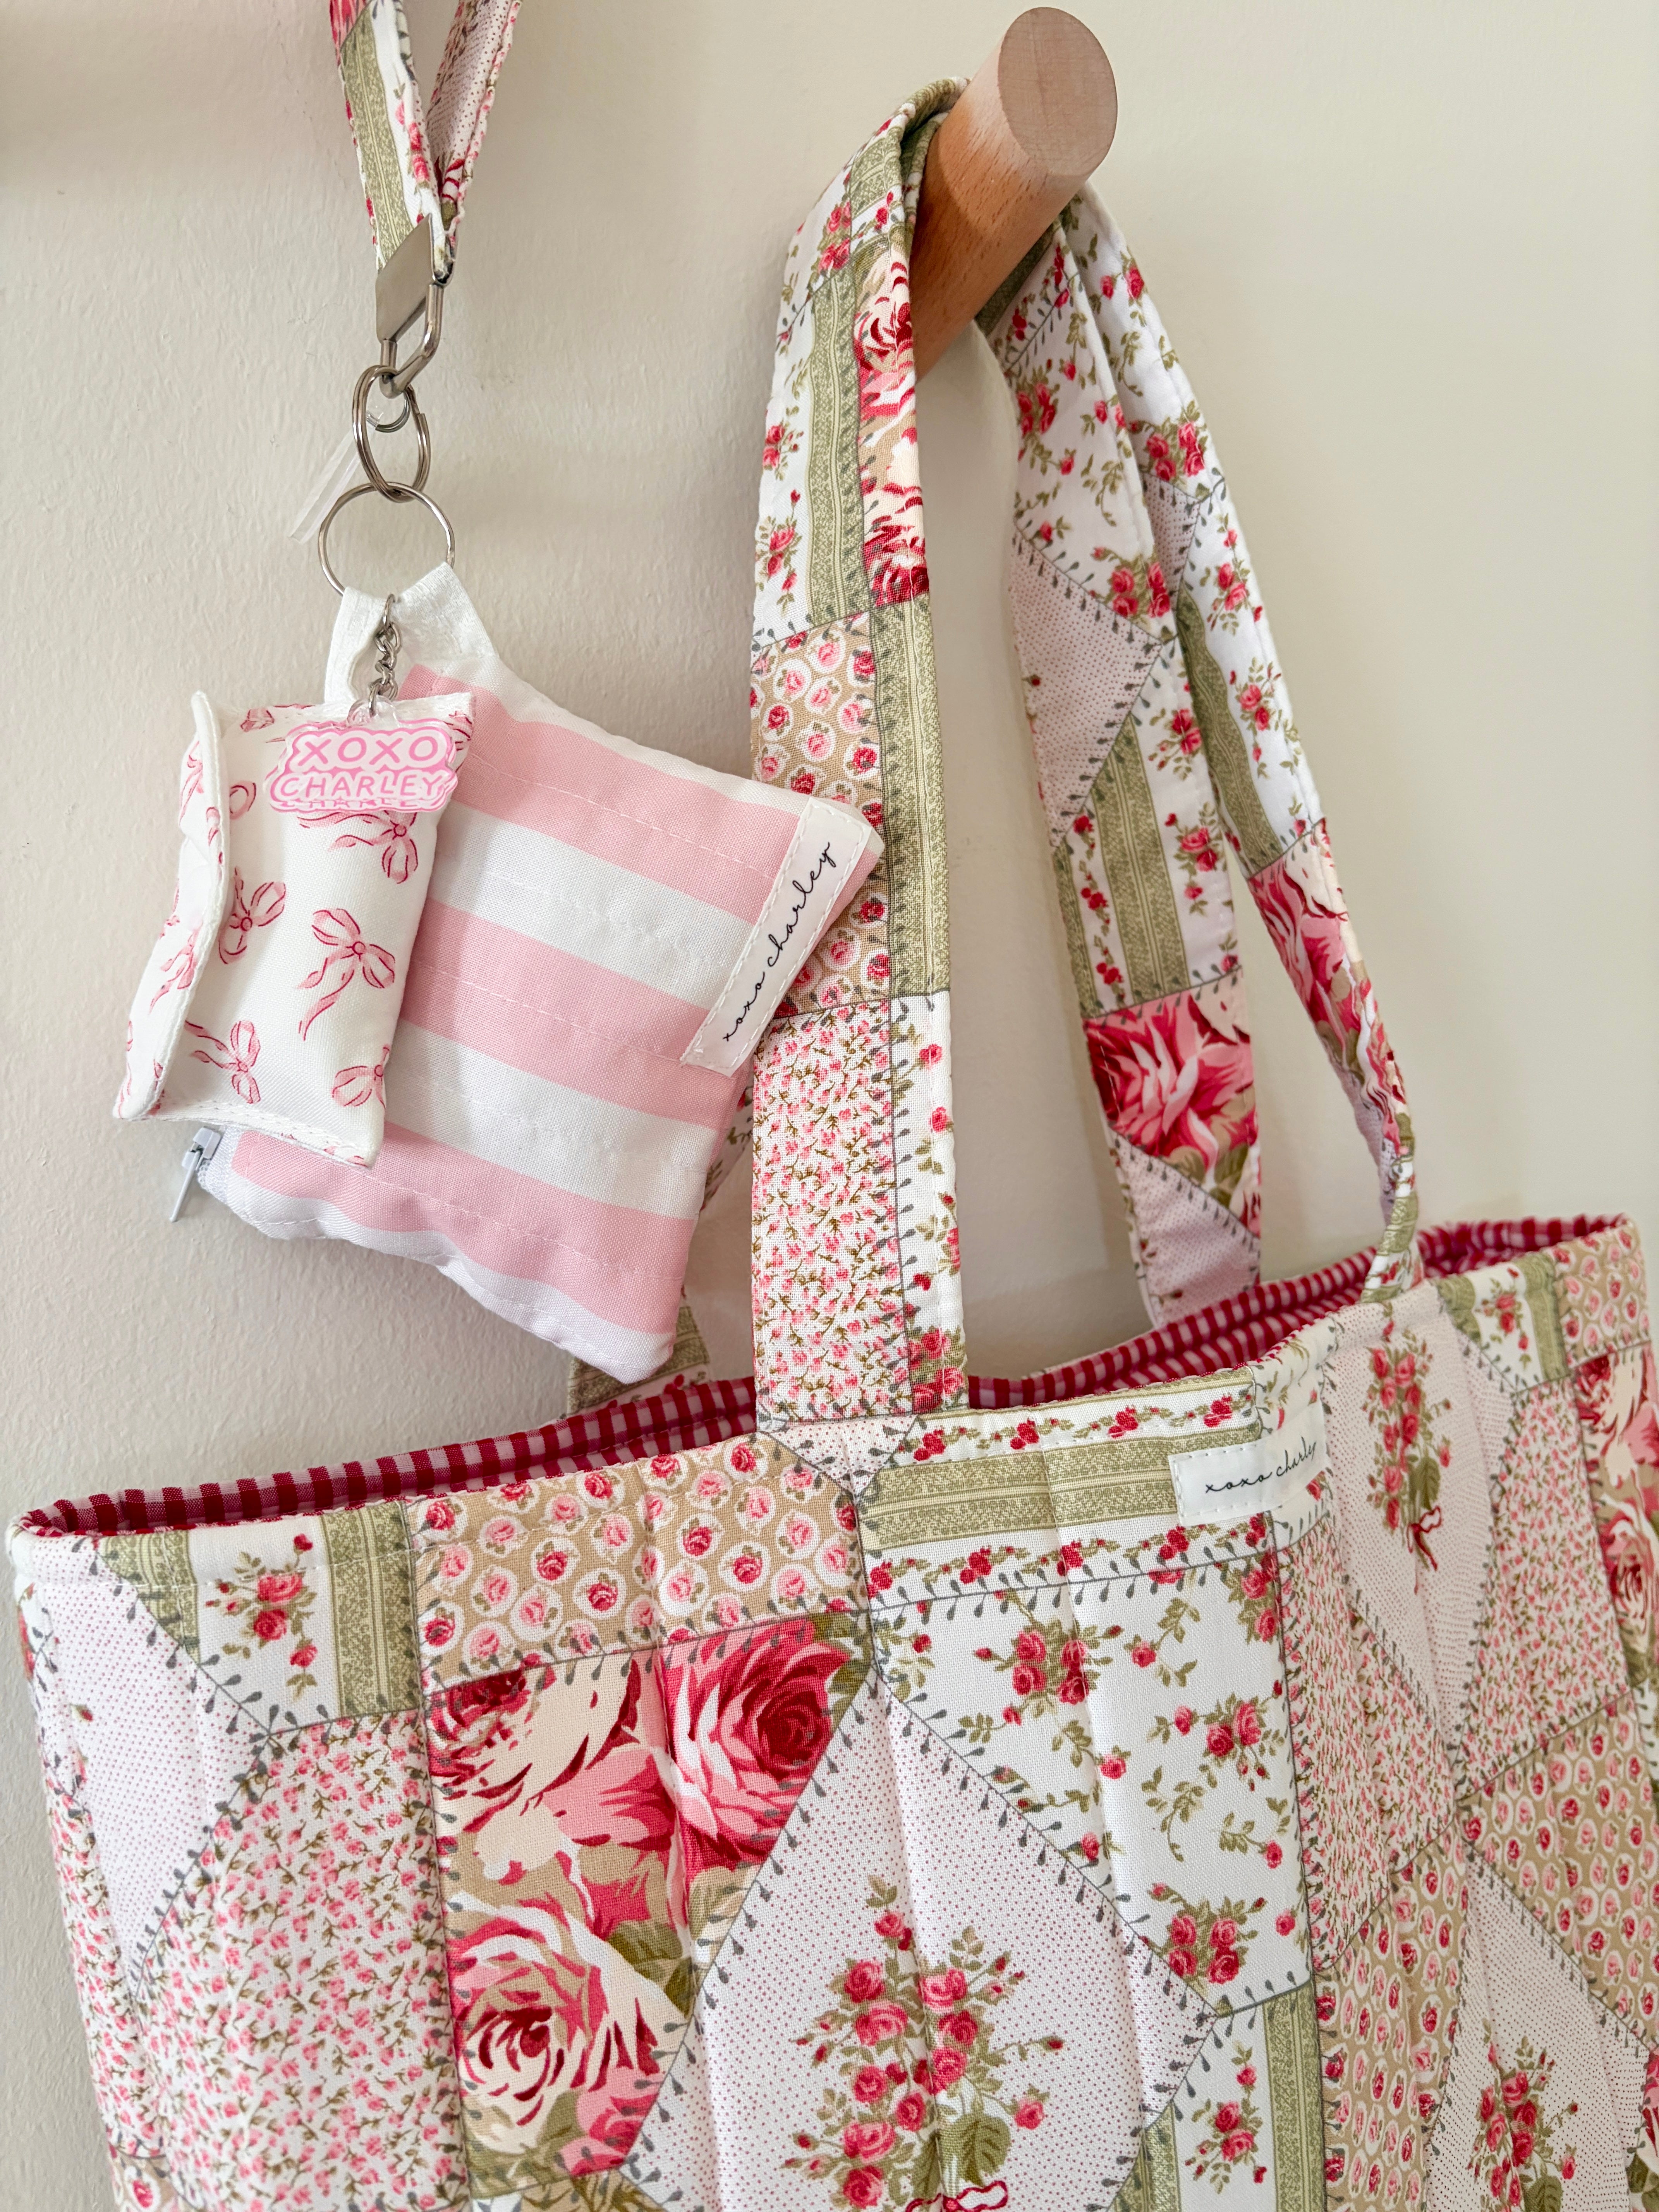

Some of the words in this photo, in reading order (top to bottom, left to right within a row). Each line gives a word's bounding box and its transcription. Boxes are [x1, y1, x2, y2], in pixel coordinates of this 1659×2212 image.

[297, 736, 438, 766] XOXO
[280, 773, 442, 798] CHARLEY
[723, 971, 765, 1041] xoxo
[767, 842, 836, 967] charley
[1205, 1472, 1273, 1493] xoxo
